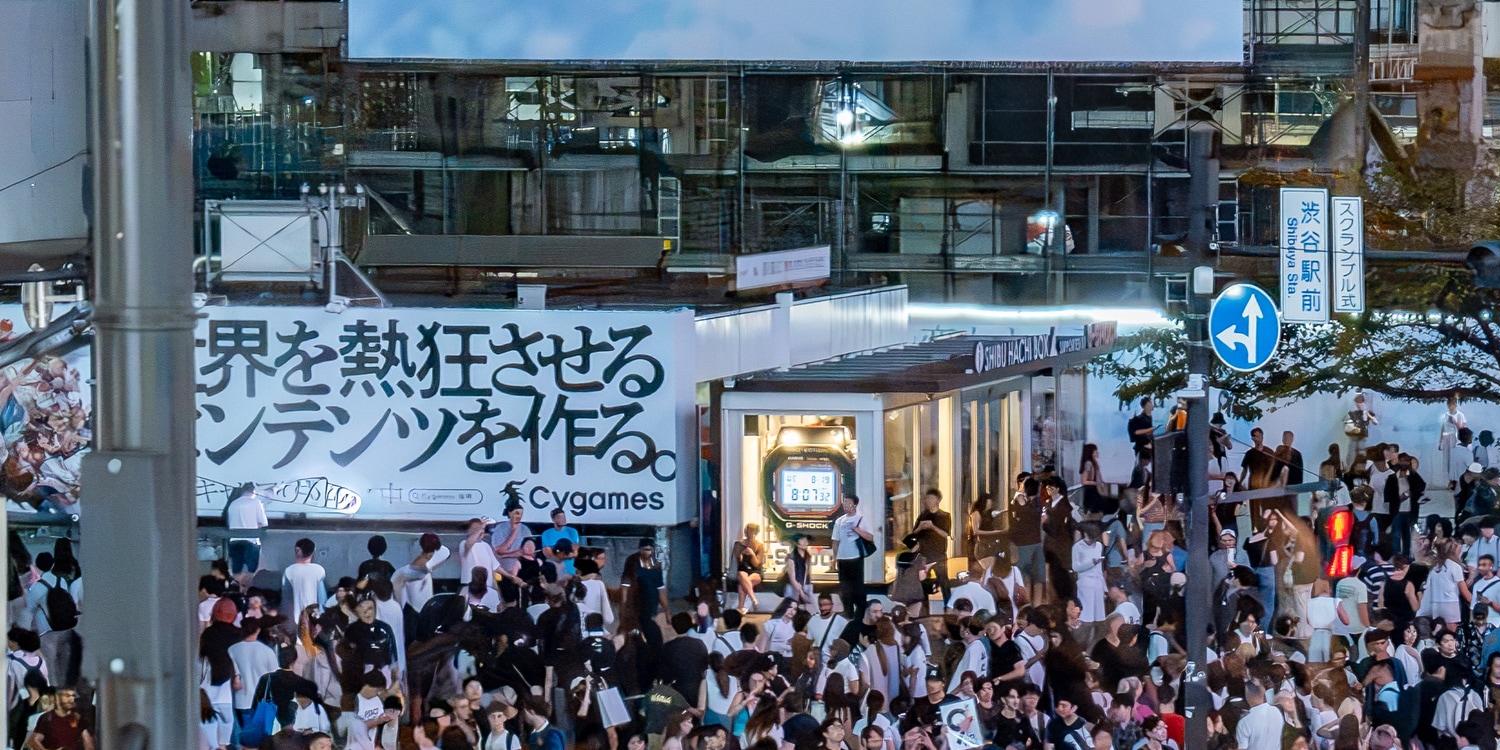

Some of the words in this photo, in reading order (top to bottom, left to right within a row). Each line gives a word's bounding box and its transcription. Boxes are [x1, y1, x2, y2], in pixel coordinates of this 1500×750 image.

[1286, 217, 1299, 268] Shibuya
[1300, 200, 1321, 312] 渋谷駅前
[1340, 203, 1357, 308] スクランブル式
[1287, 273, 1299, 299] Sta.
[196, 319, 665, 399] 界を熱狂させる
[984, 342, 1007, 371] SHIBU
[1008, 336, 1032, 366] HACHI
[1034, 333, 1050, 359] BOX
[196, 394, 677, 482] ンテンツを作る。
[529, 486, 665, 516] Cygames
